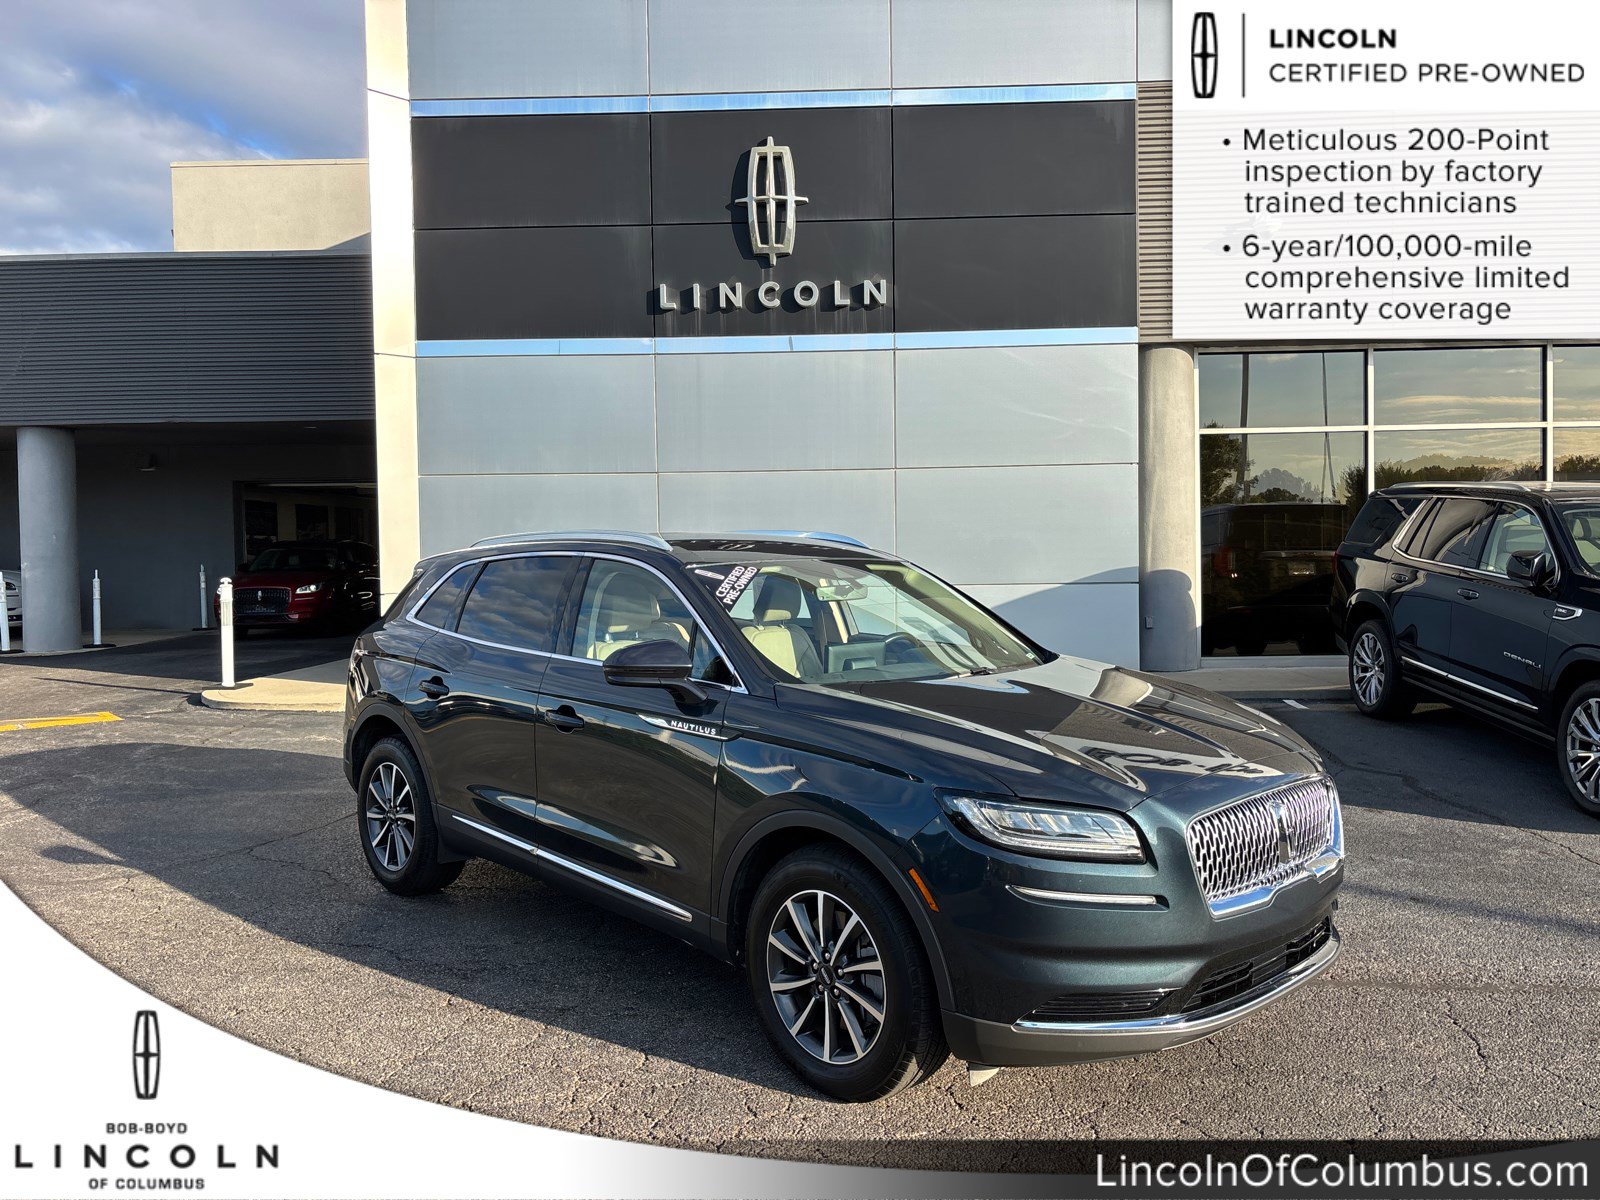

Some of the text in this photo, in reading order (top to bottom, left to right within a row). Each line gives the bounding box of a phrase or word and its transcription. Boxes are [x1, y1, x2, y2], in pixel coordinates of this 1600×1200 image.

[660, 280, 887, 310] LINCOLN
[716, 566, 745, 597] CERTIFIED
[723, 566, 758, 605] PRE-OWNED
[1503, 651, 1541, 669] DENALI
[670, 720, 717, 735] NAUTILUS
